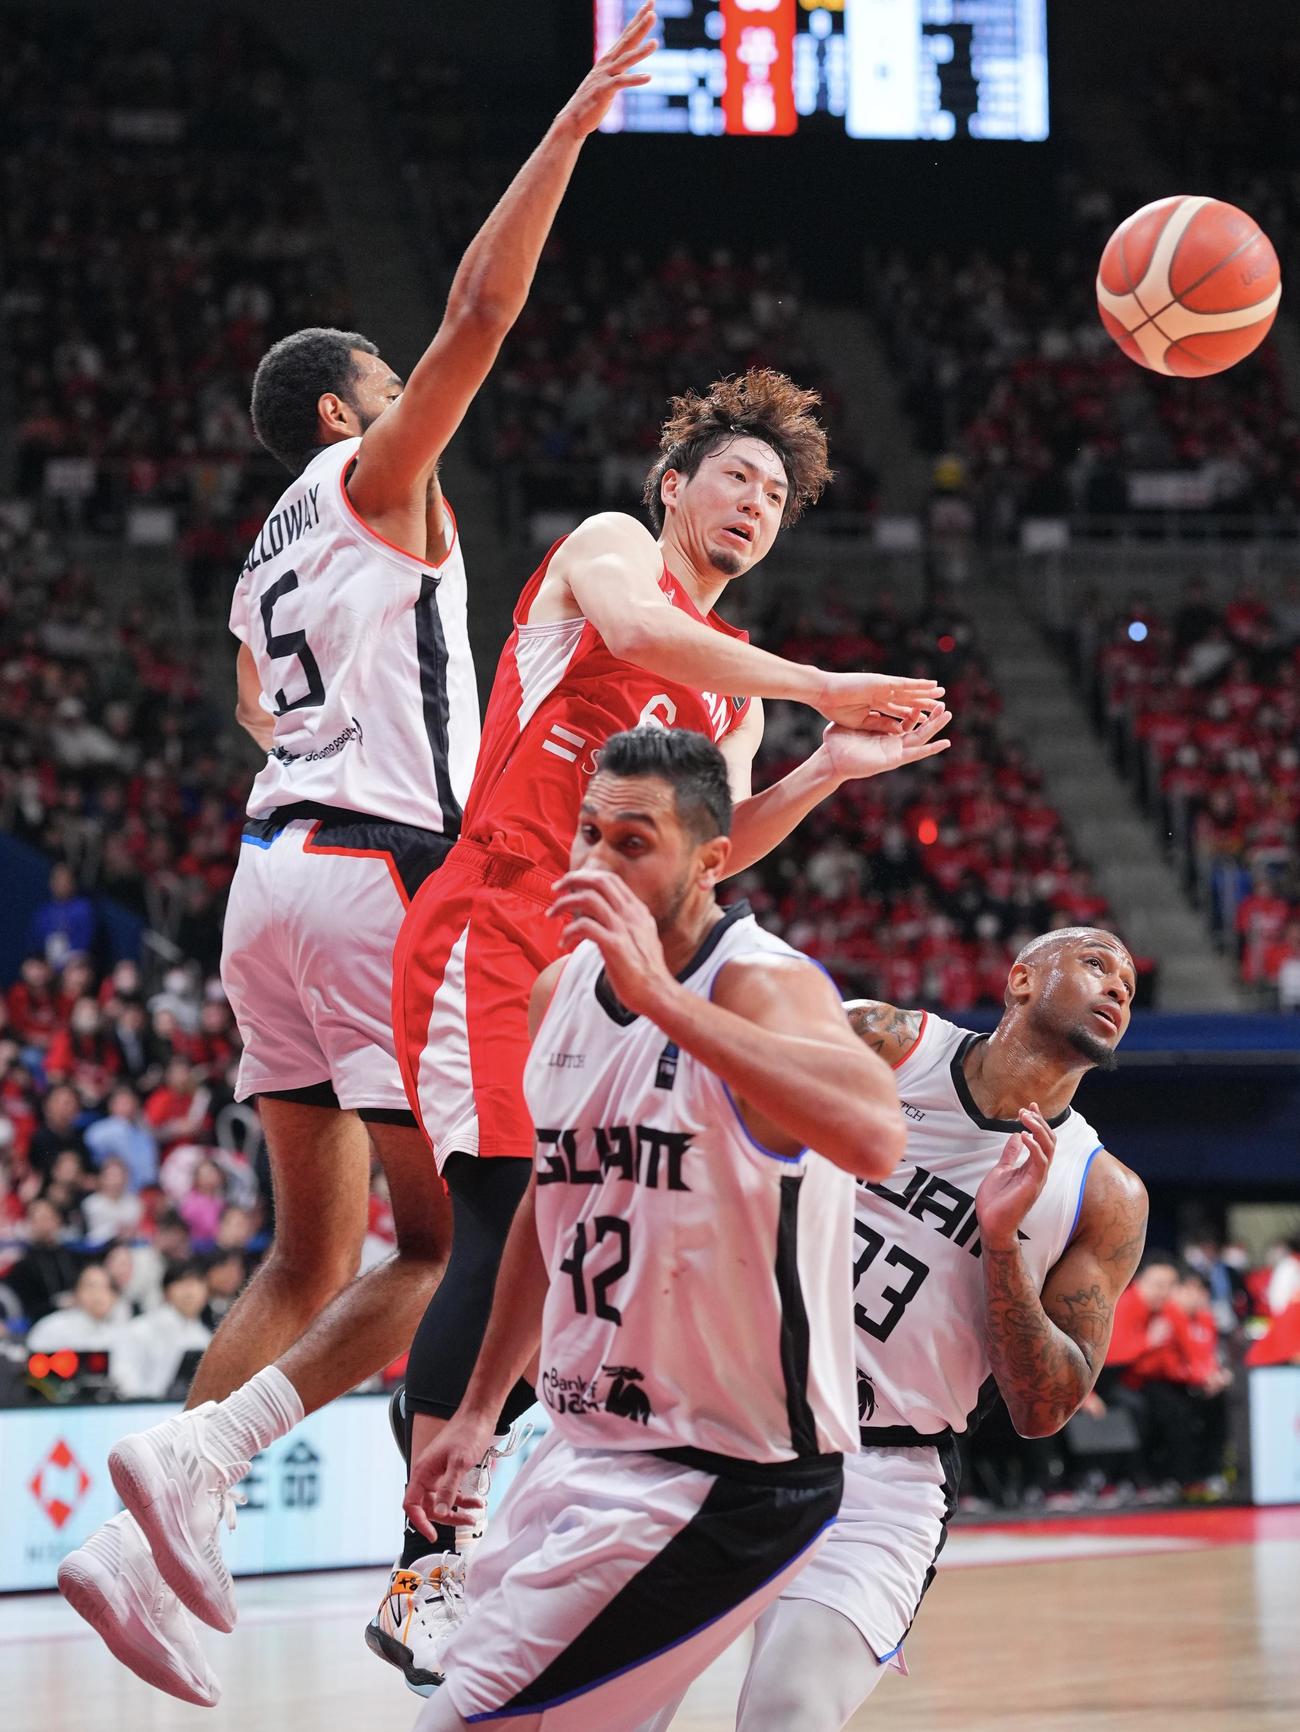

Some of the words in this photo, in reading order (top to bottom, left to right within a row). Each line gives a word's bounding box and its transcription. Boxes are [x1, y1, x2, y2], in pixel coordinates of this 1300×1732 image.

[240, 482, 320, 579] ALLOWAY
[260, 568, 326, 718] 5
[547, 1052, 586, 1069] LUTCH
[900, 1099, 926, 1122] TCH
